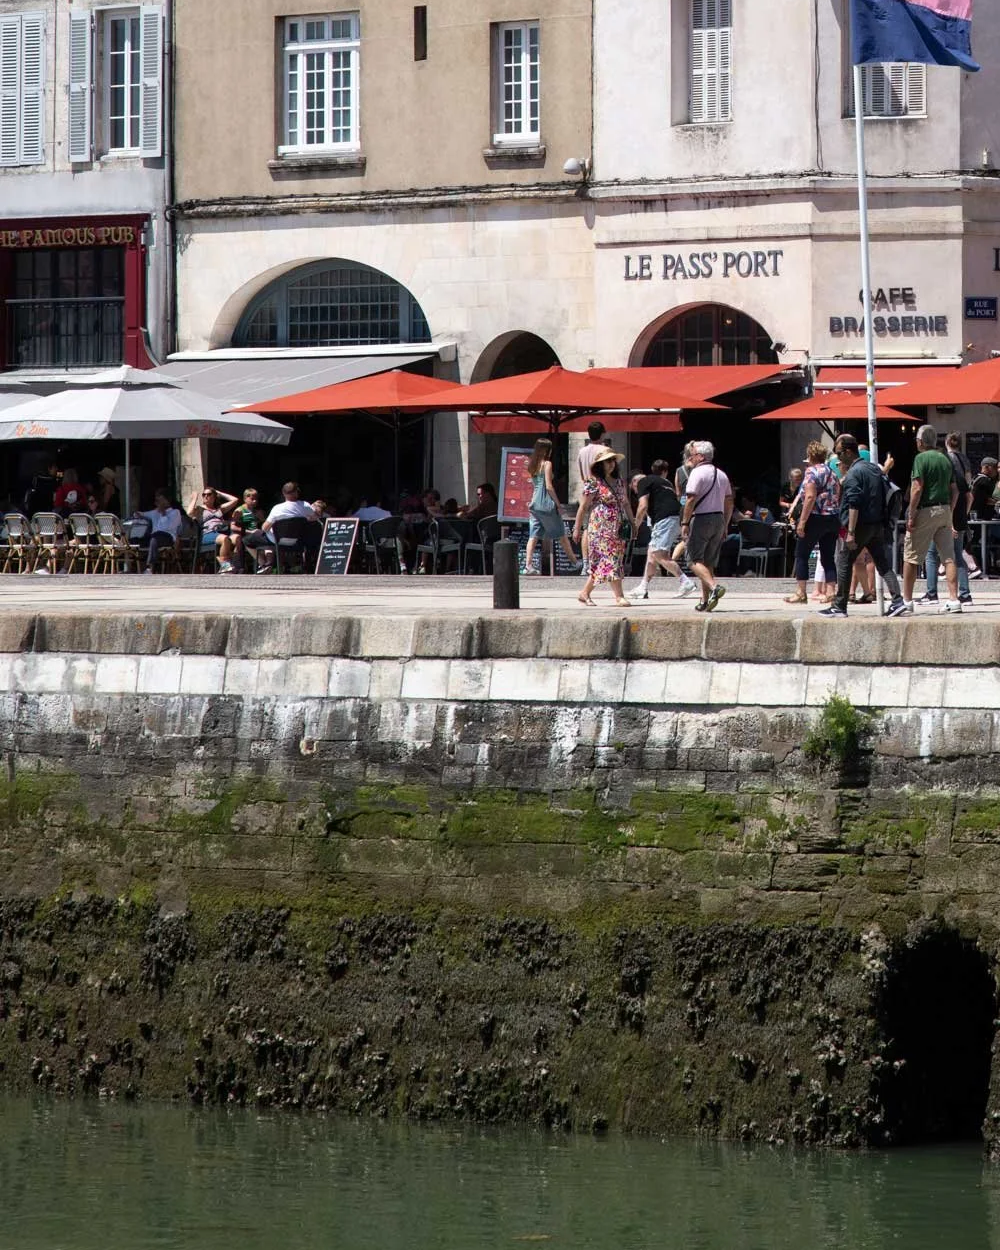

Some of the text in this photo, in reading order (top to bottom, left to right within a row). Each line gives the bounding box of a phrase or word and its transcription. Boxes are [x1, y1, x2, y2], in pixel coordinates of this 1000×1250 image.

[23, 227, 96, 247] FAMOUS
[100, 226, 134, 244] PUB
[624, 255, 652, 281] LE
